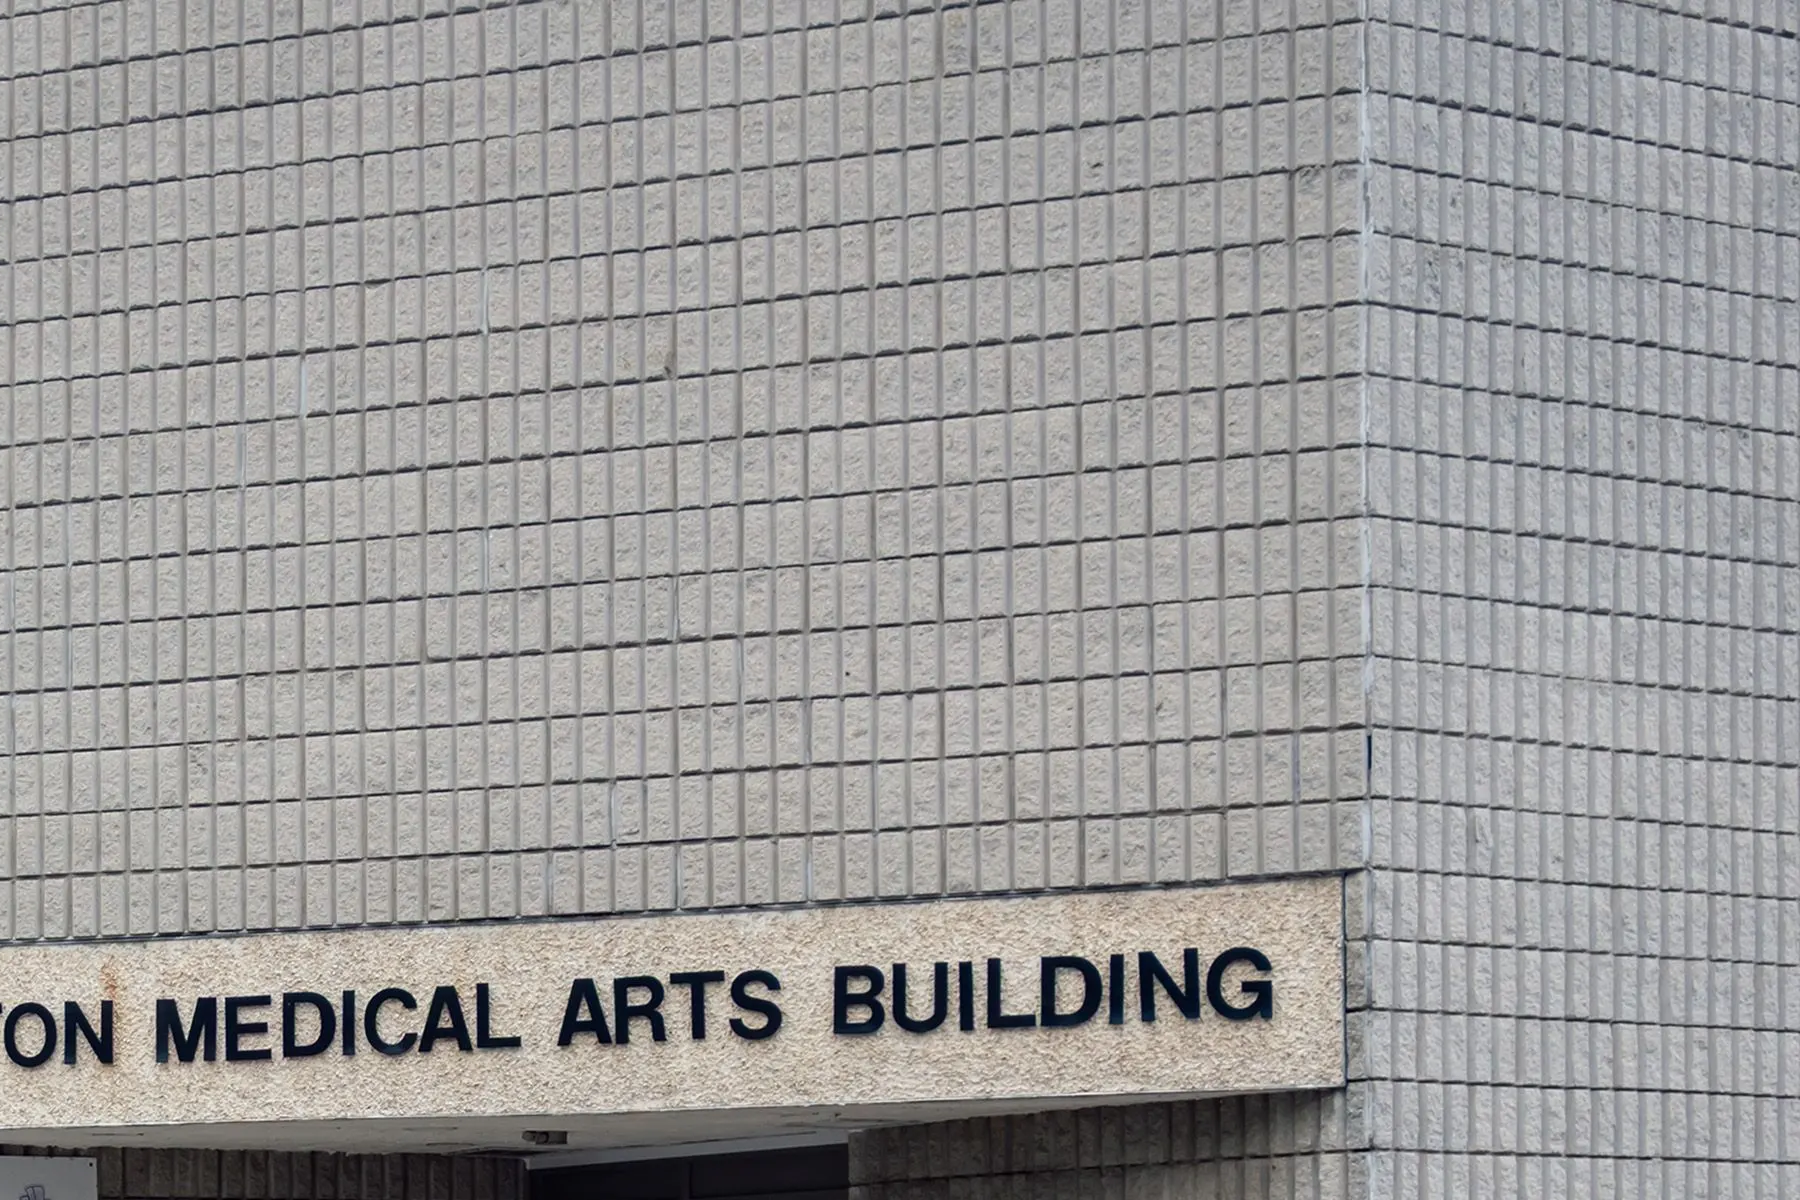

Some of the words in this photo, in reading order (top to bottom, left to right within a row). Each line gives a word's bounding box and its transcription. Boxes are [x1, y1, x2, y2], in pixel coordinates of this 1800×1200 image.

[155, 982, 523, 1065] MEDICAL
[557, 969, 783, 1047] ARTS
[833, 946, 1274, 1036] BUILDING
